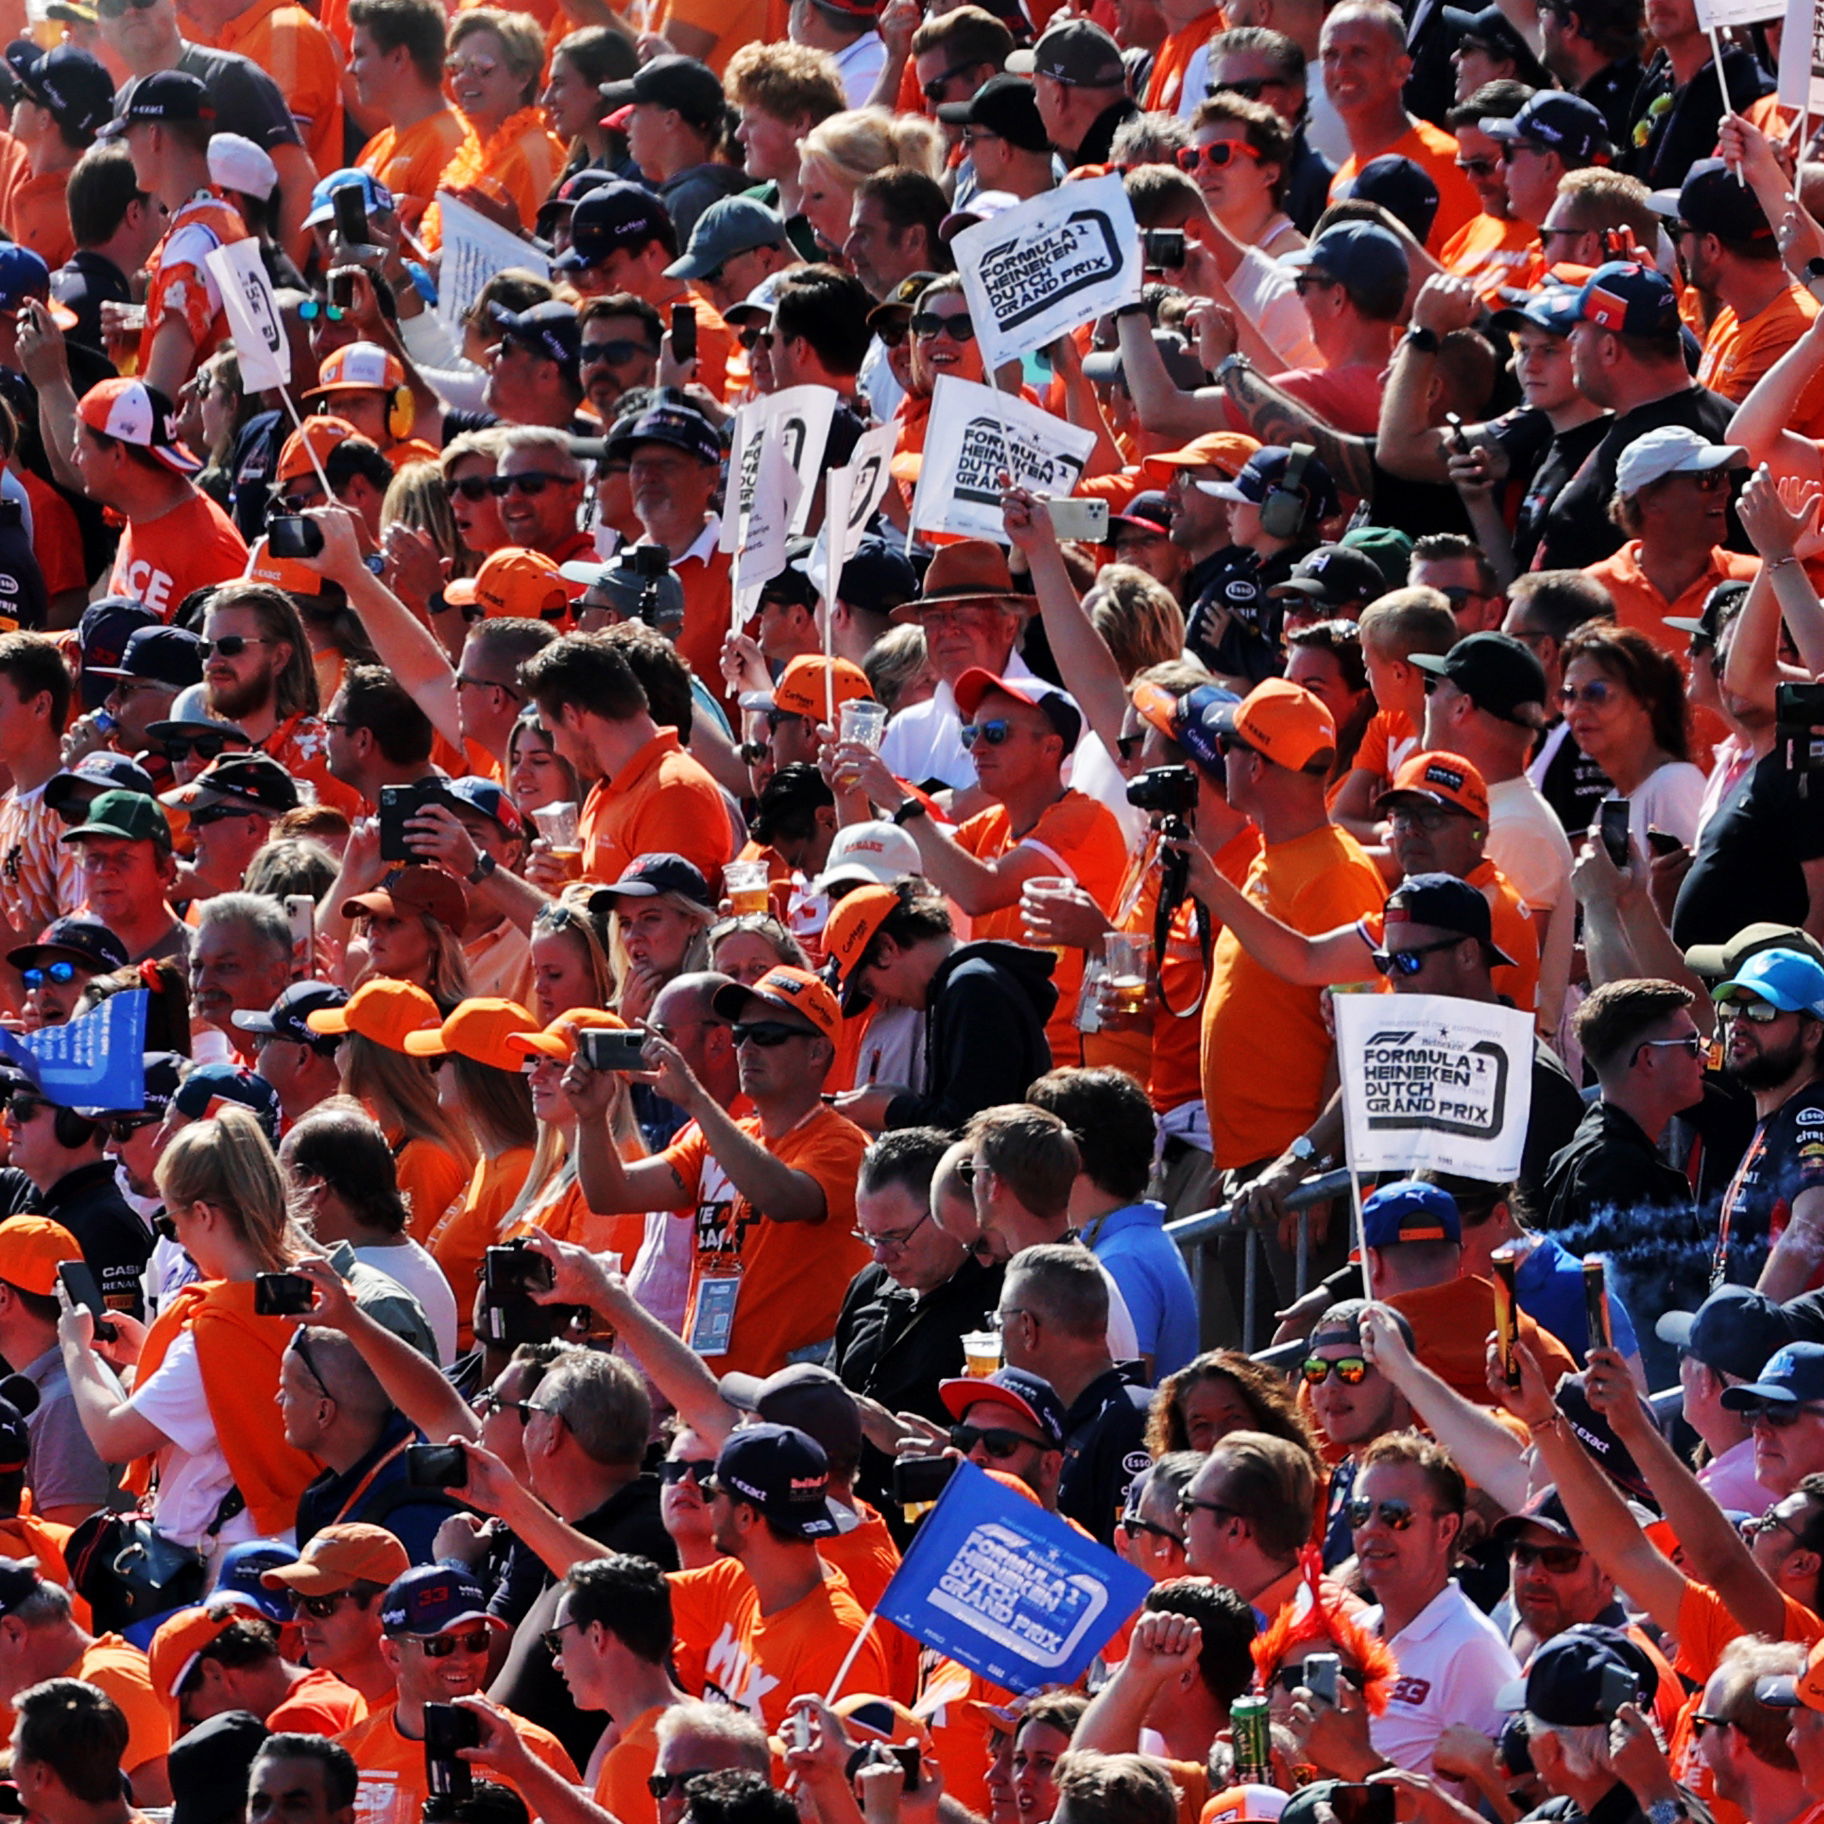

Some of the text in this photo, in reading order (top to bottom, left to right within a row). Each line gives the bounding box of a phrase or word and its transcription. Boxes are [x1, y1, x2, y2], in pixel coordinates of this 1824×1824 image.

[980, 224, 1089, 282] FORMULA 1
[985, 240, 1078, 294] HEINEKEN
[990, 268, 1052, 307] DUTCH
[995, 257, 1107, 318] GRAND PRIX
[1060, 466, 1068, 478] 1
[1364, 1050, 1486, 1072] FORMULA 1
[1365, 1065, 1470, 1086] HEINEKEN
[1365, 1081, 1433, 1096] DUTCH
[1367, 1096, 1488, 1123] GRAND PRIX
[1801, 1112, 1823, 1121] Esso
[1577, 1427, 1609, 1454] exact
[1128, 1458, 1151, 1468] Esso
[801, 1520, 832, 1533] 33
[958, 1545, 1060, 1612] HEINEKEN
[968, 1529, 1079, 1606] FORMULA 1
[418, 1586, 449, 1607] 33
[949, 1560, 1021, 1608] DUTCH
[939, 1575, 1062, 1651] GRAND PRIX
